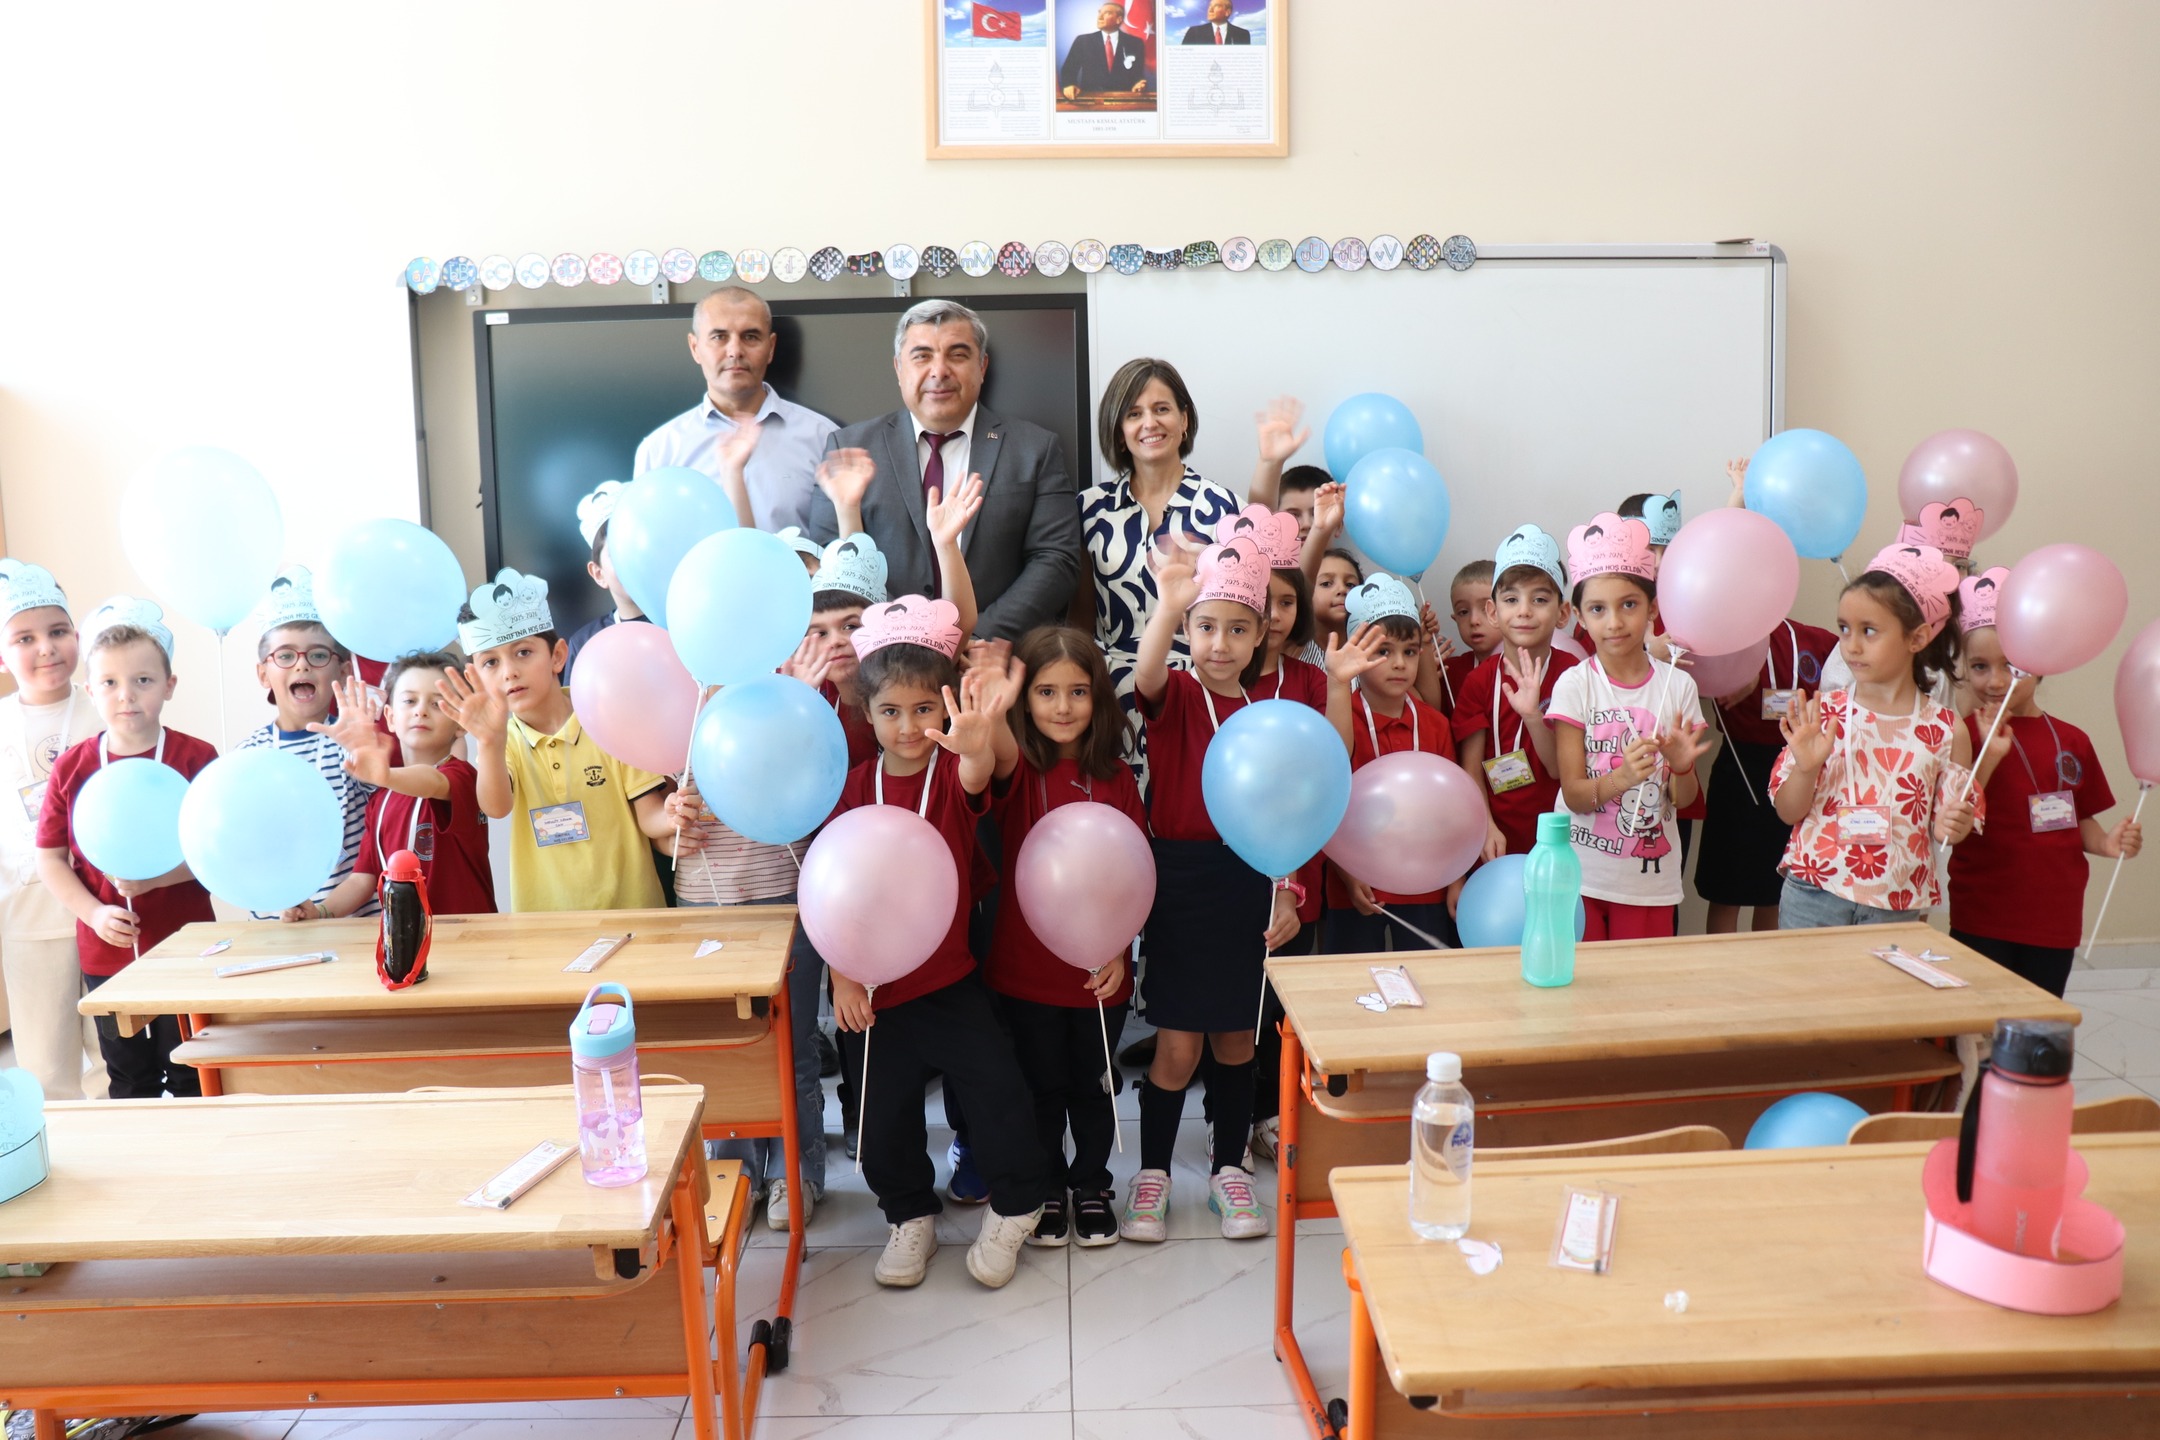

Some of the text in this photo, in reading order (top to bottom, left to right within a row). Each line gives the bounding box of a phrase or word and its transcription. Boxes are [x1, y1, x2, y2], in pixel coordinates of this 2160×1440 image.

[630, 257, 655, 276] fF
[665, 253, 692, 280] gG
[741, 253, 766, 273] hH
[892, 249, 912, 269] kK
[960, 249, 993, 268] mM
[1002, 250, 1027, 269] nN
[1038, 247, 1067, 267] oO
[1267, 243, 1286, 264] tT
[1300, 242, 1324, 261] uU
[1374, 242, 1398, 261] vV
[1451, 244, 1470, 263] zZ
[1605, 565, 1620, 573] HOŞ
[496, 628, 528, 644] SINIFINA
[903, 635, 920, 643] HOŞ
[920, 637, 946, 651] GELDİN
